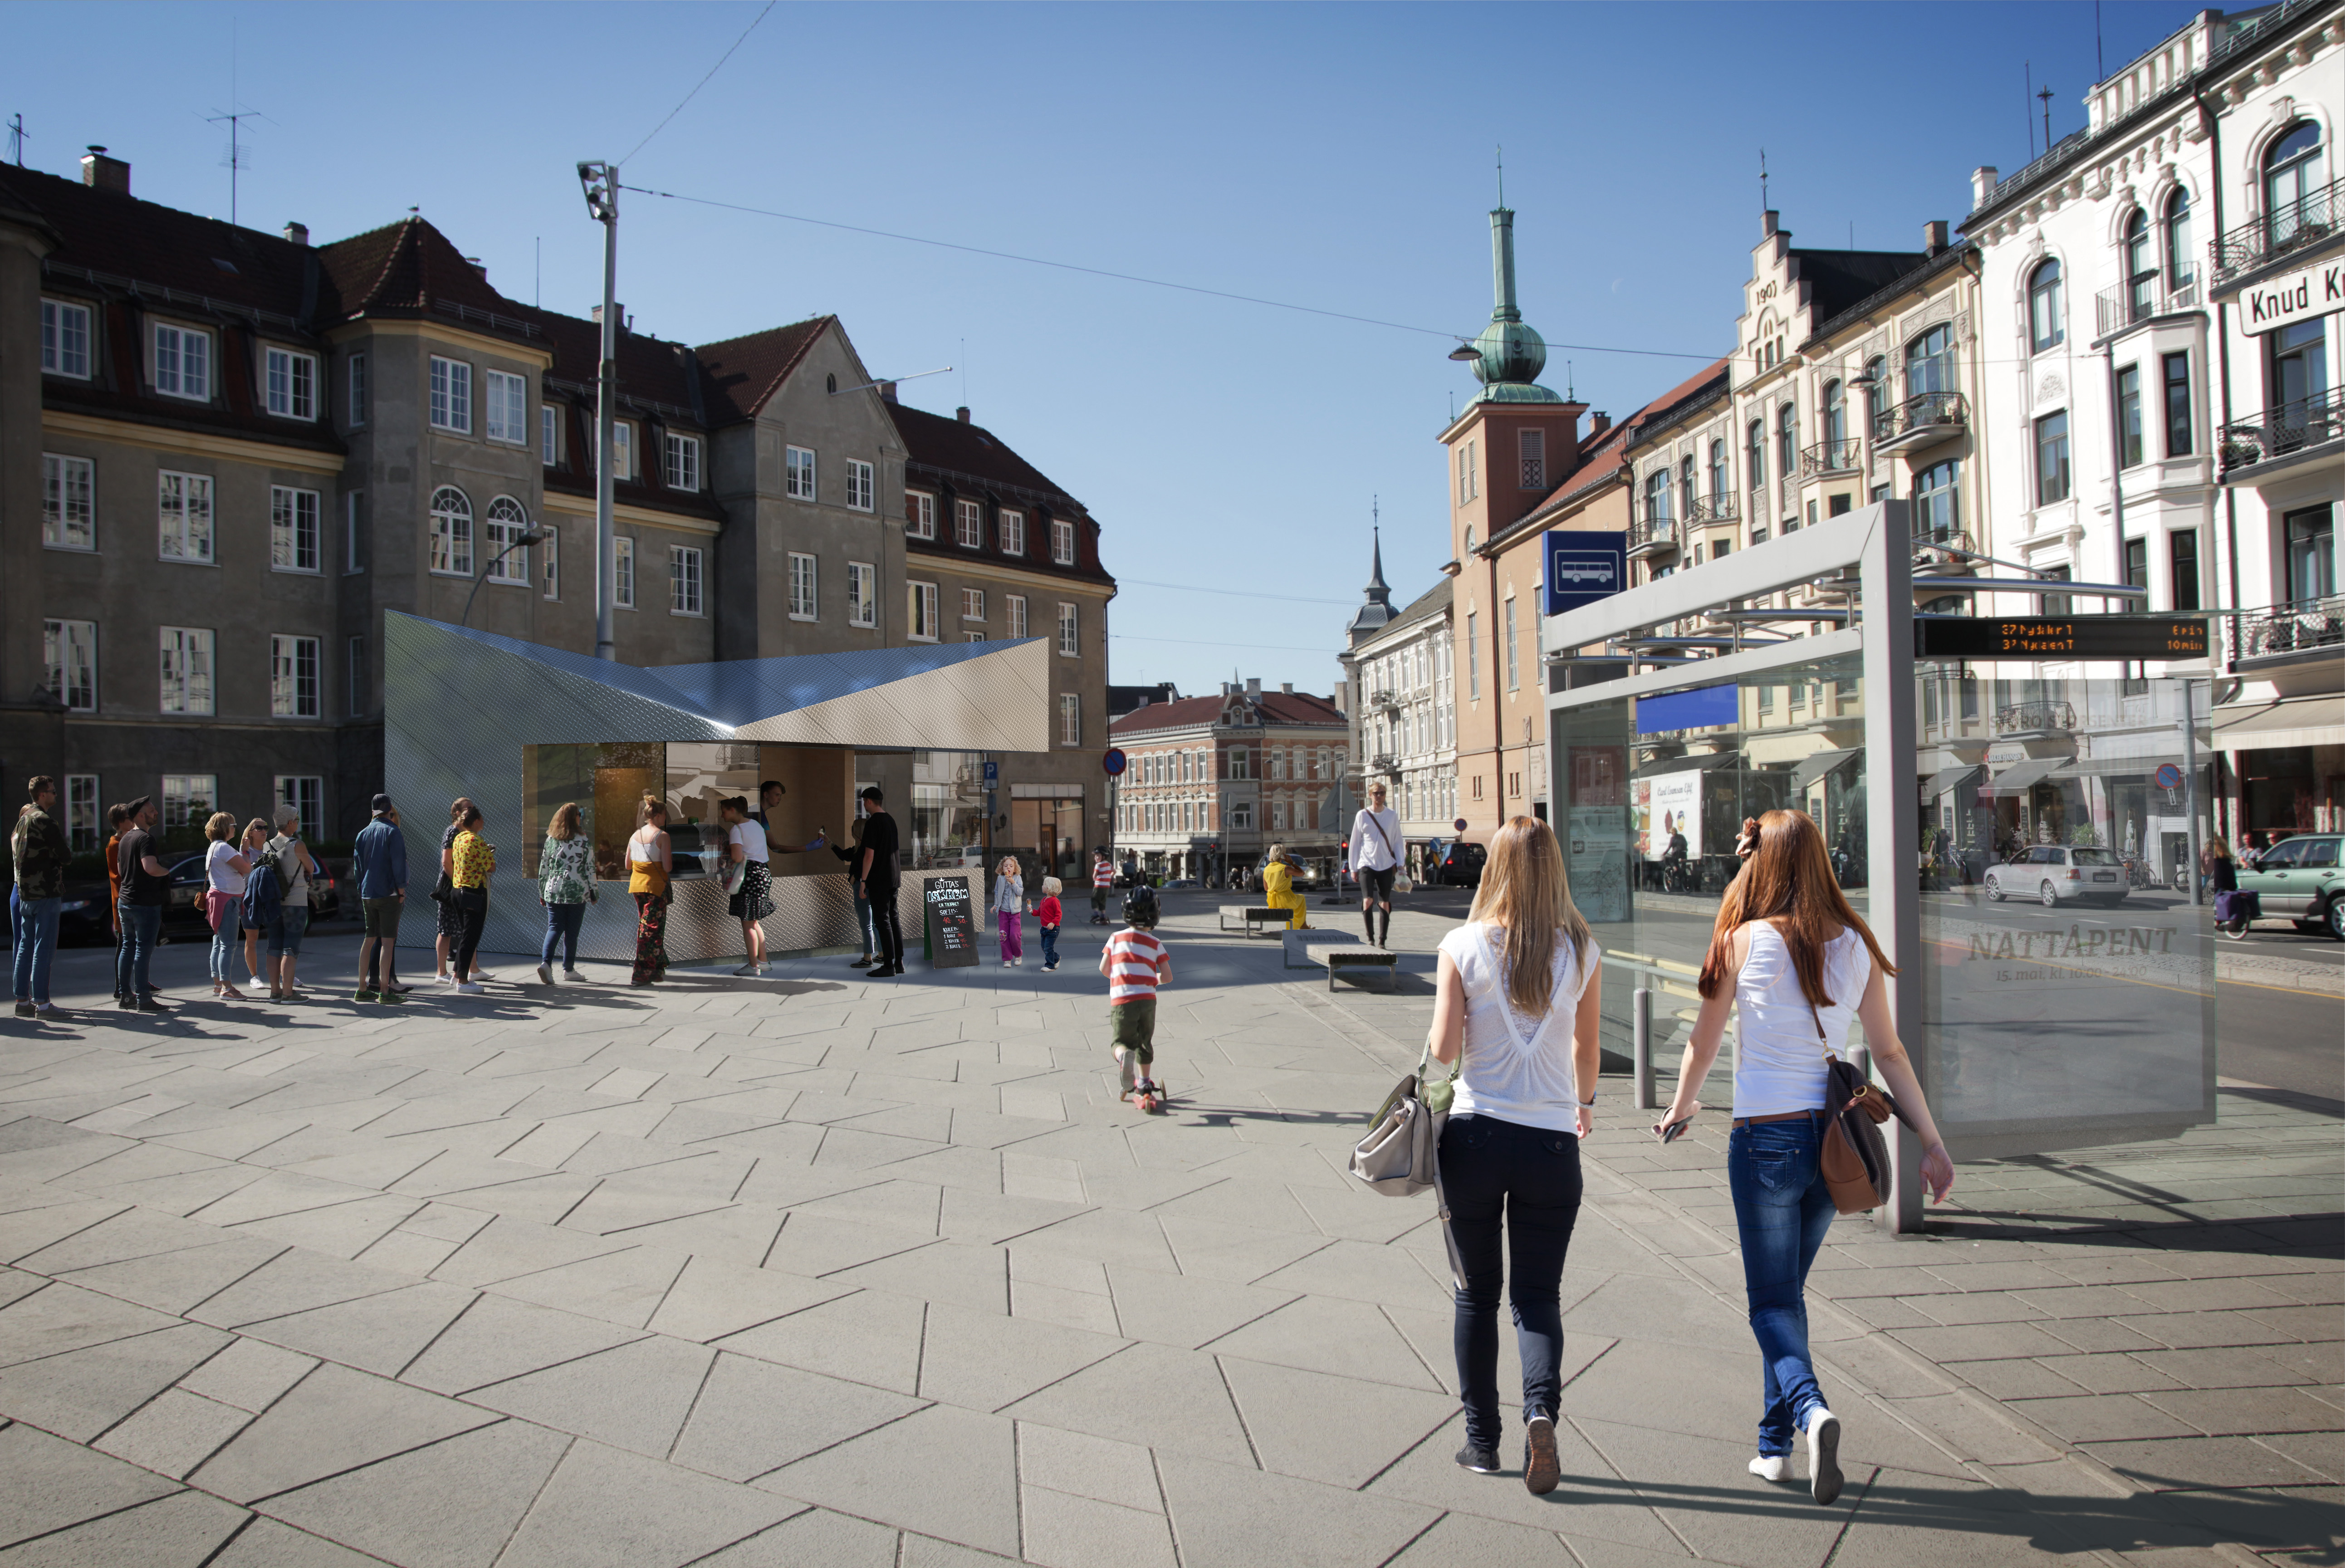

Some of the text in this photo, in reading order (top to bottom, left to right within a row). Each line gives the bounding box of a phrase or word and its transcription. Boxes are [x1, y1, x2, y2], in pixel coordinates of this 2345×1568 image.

[2251, 277, 2308, 323] Knud
[987, 764, 994, 777] P
[1658, 786, 1667, 796] Carl
[935, 881, 959, 889] GUTTA'S
[927, 889, 969, 902] ISKREM
[1968, 924, 2177, 961] NATTÅPENT
[1996, 970, 2012, 982] 15.
[2014, 967, 2046, 981] mai,
[2049, 966, 2065, 979] kl.
